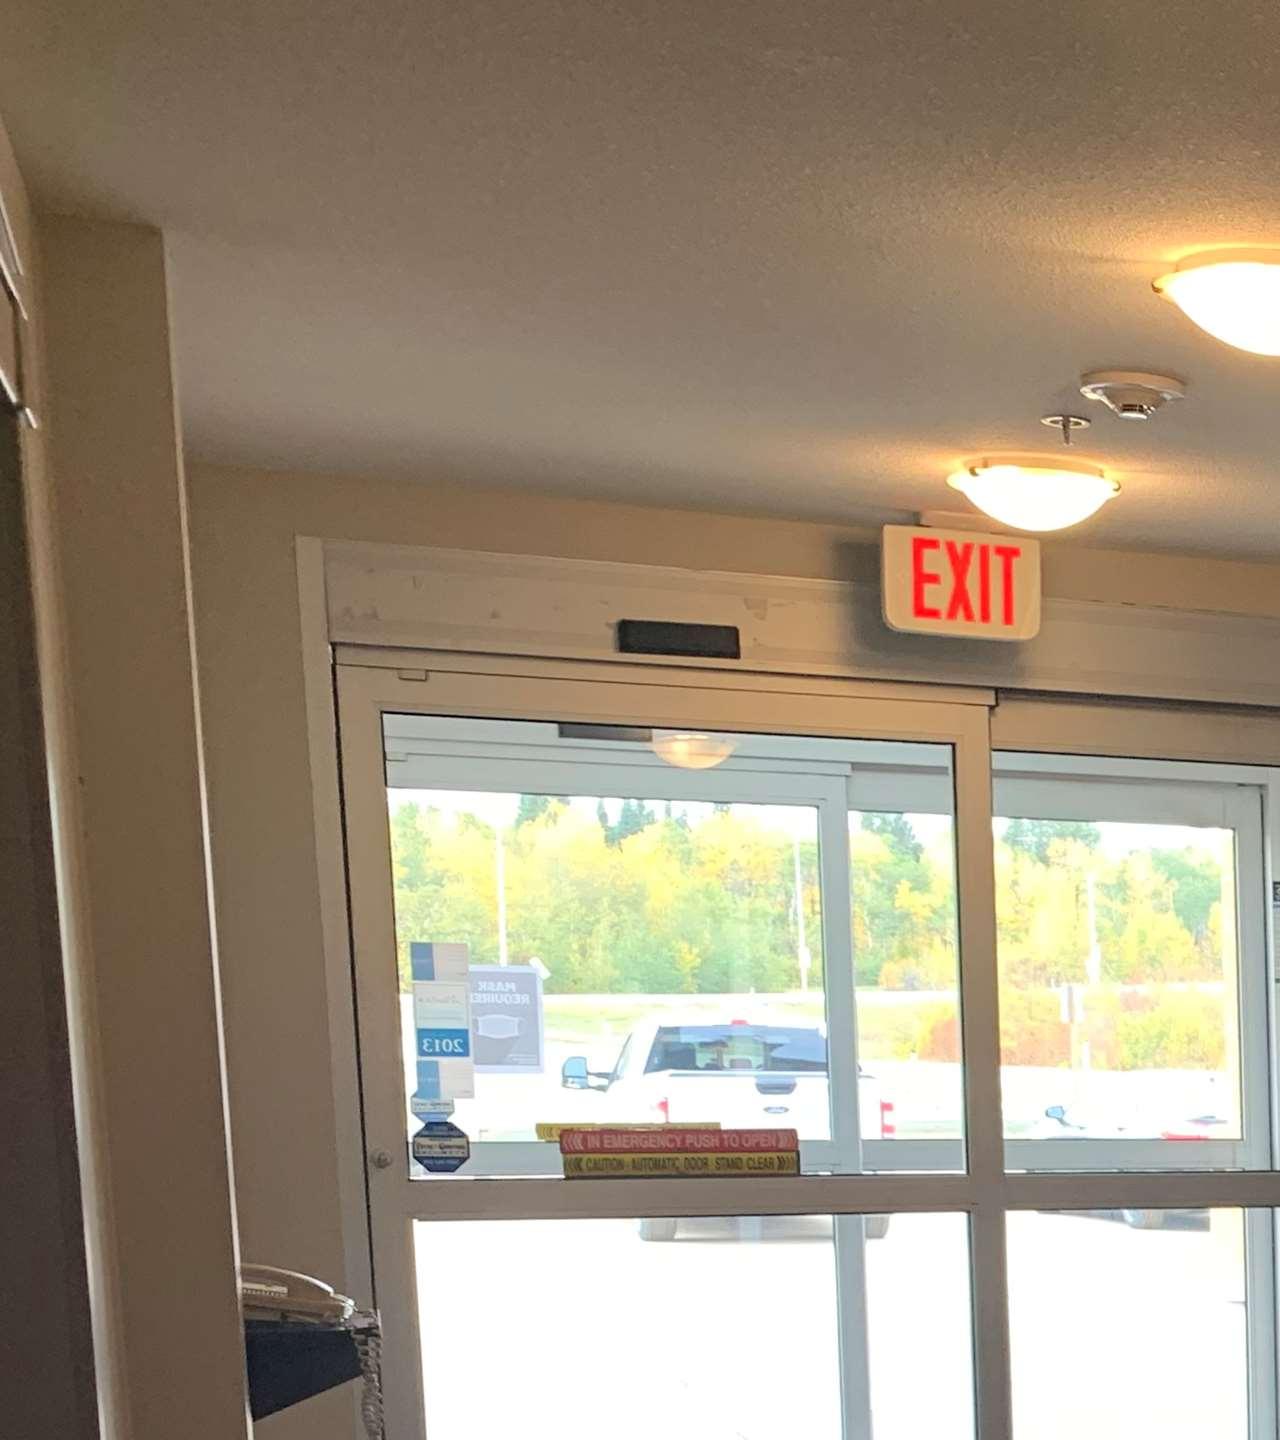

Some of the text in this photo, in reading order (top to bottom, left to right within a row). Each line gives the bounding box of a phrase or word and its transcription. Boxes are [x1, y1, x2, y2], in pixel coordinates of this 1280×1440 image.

[912, 537, 1022, 626] EXIT
[587, 1133, 777, 1149] IN EMERGENCY PUSH TO OPEN
[586, 1156, 775, 1170] CAUTION AUTOMATIC DOOR STAND CLEAR
